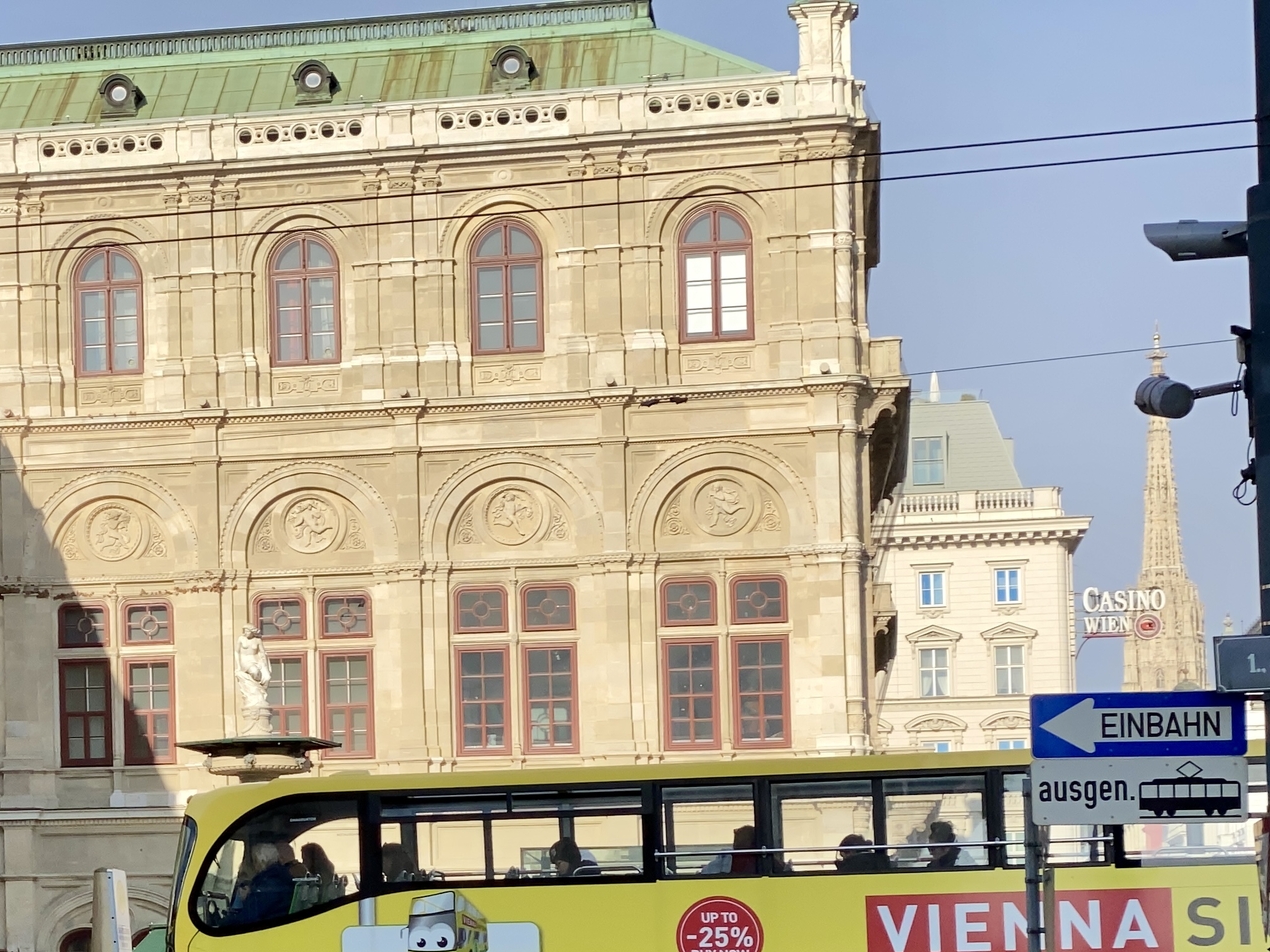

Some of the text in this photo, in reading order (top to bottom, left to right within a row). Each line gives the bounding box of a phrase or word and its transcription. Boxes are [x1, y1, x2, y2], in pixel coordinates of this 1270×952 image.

[1083, 587, 1166, 612] CASINO
[1084, 615, 1130, 633] WIEN
[1101, 711, 1221, 738] EINBAHN
[1039, 779, 1135, 810] ausgen.
[701, 912, 738, 923] UP TO
[686, 926, 754, 948] -25%
